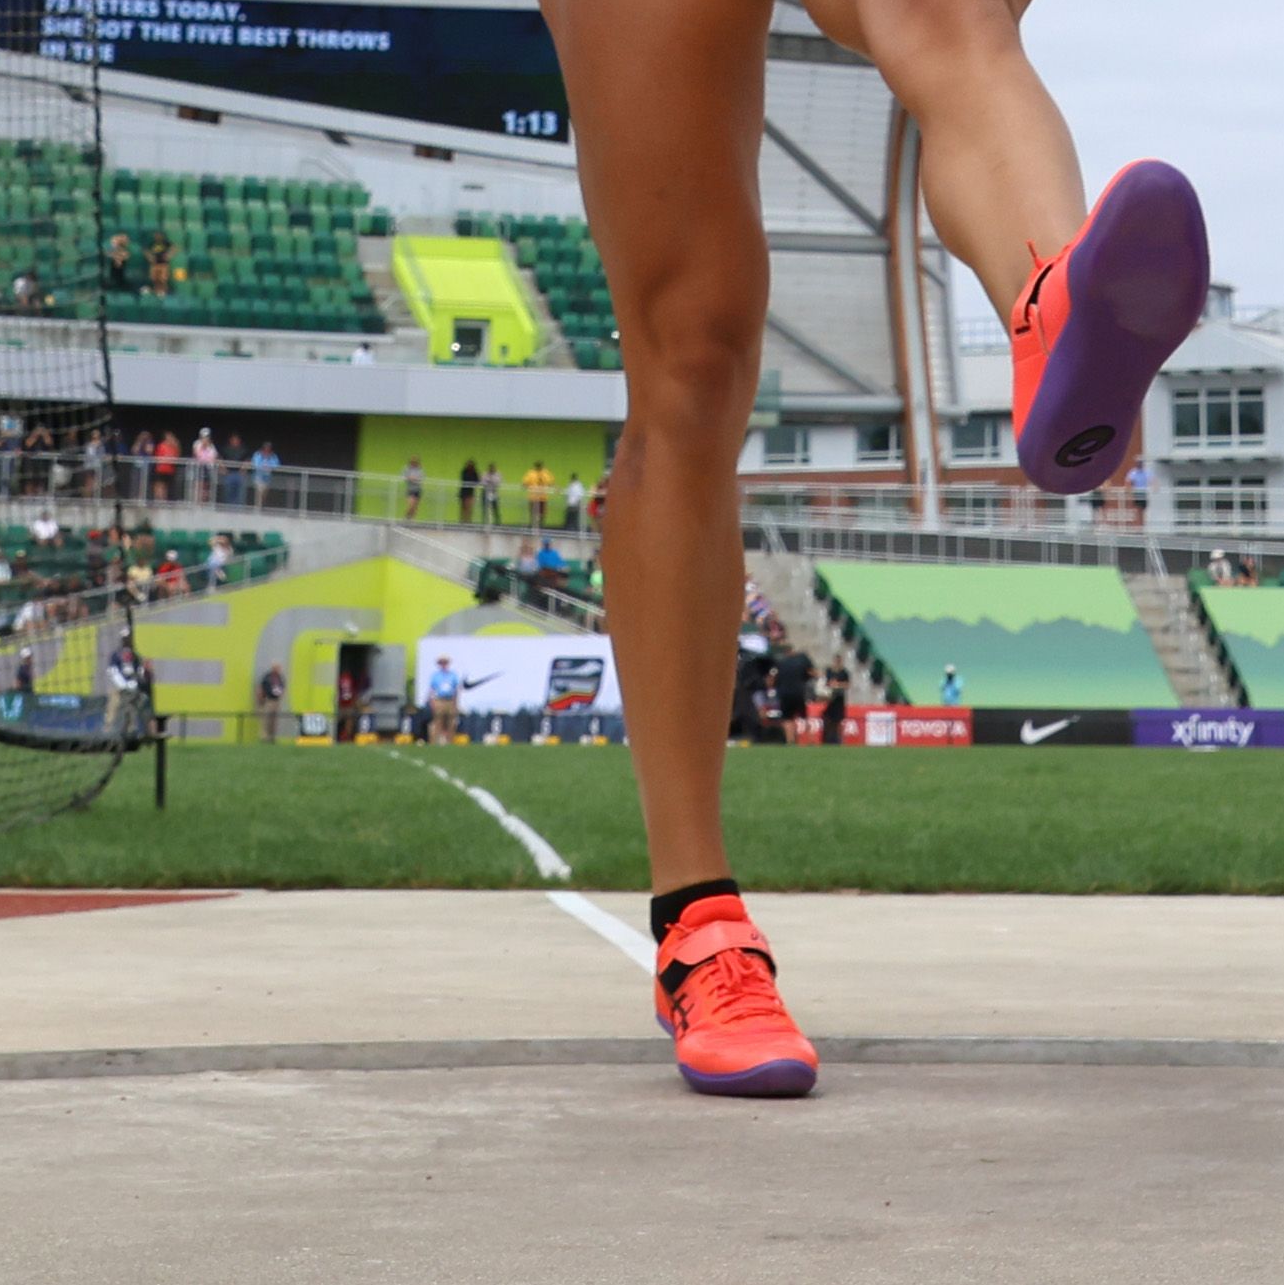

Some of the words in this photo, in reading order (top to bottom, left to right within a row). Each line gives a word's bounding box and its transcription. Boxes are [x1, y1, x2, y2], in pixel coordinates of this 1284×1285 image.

[164, 0, 246, 22] TODAY.
[41, 16, 84, 37] SHE
[138, 22, 182, 42] THE
[185, 24, 233, 45] FIVE
[237, 26, 291, 48] BEST
[295, 28, 391, 51] THROWS
[502, 110, 558, 136] 1:13
[899, 719, 968, 738] TOYOTA
[1172, 714, 1255, 748] xfinity
